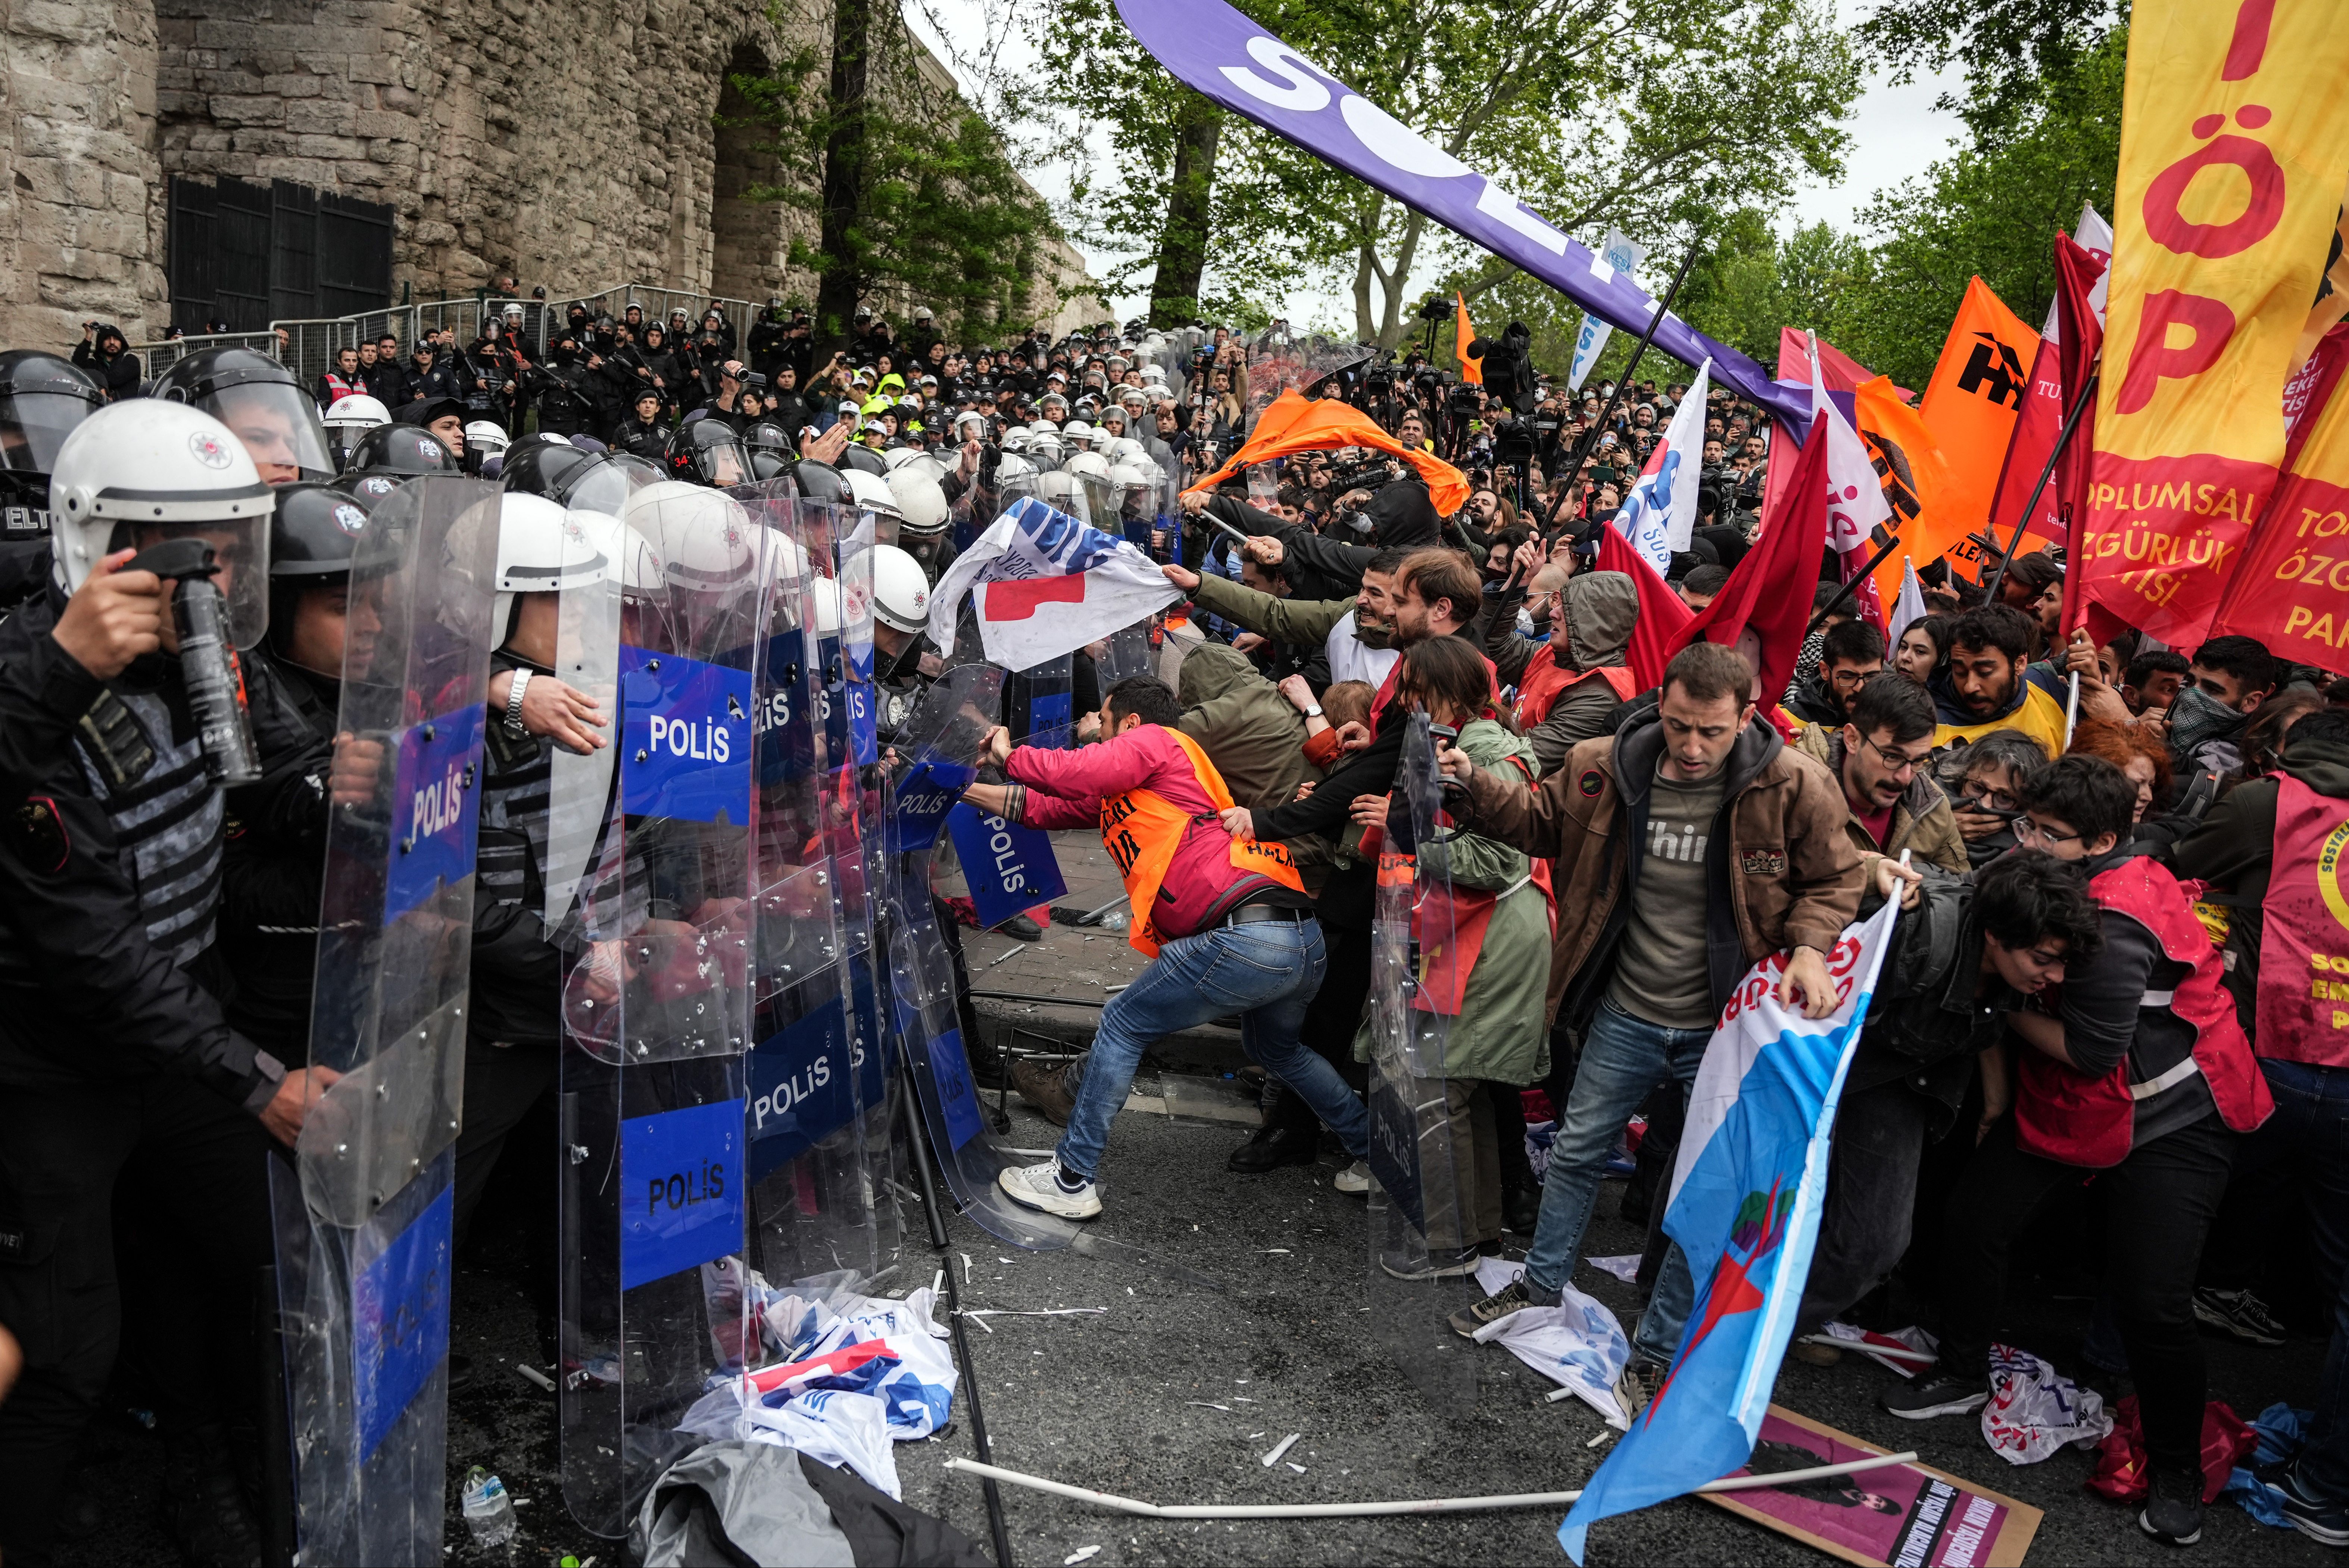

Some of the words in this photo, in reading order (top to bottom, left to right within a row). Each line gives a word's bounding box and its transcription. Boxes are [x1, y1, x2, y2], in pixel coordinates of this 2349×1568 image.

[1608, 249, 1631, 273] KESK
[2038, 380, 2062, 400] TU
[674, 455, 688, 467] 34
[650, 715, 730, 763] POLİS
[412, 764, 462, 845] POLİS
[896, 791, 948, 814] POLİS
[984, 815, 1025, 894] POLİS
[754, 1056, 830, 1130] POLİS
[649, 1157, 724, 1216] POLİS
[1930, 1480, 1956, 1499] BİR
[1916, 1494, 1947, 1525] YAŞAM
[1962, 1495, 1997, 1529] HAKAN
